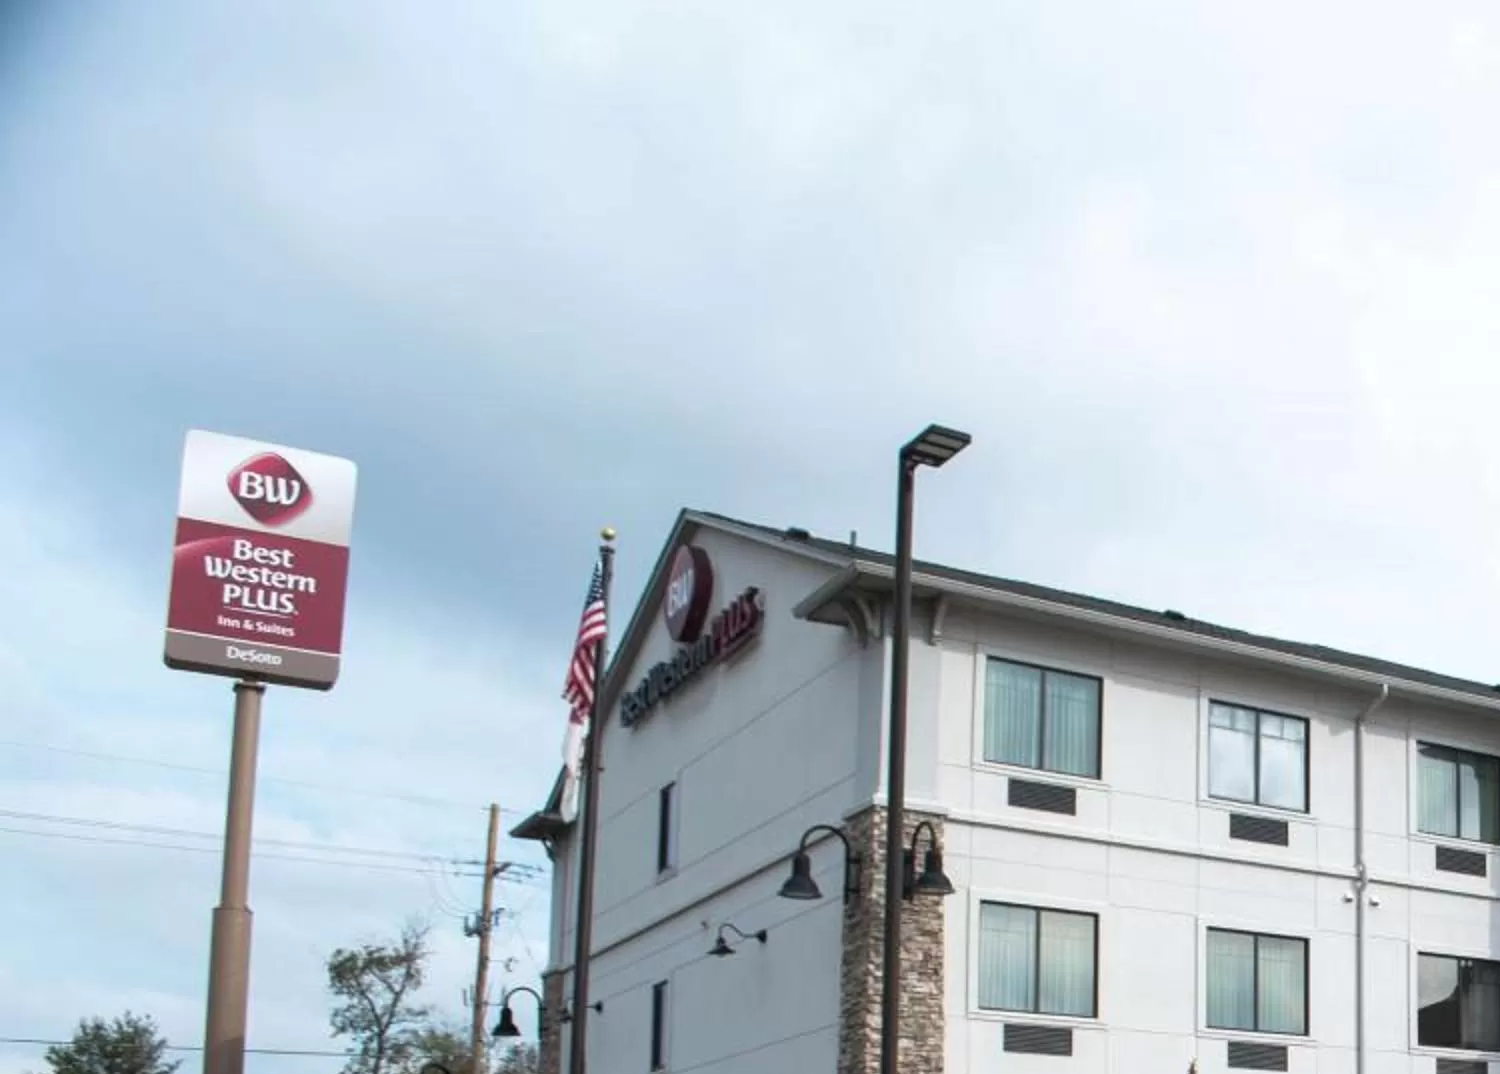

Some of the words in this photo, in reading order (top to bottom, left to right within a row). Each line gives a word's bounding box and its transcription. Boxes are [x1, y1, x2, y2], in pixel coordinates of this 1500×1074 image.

[239, 471, 300, 505] BW
[233, 539, 294, 568] Best
[204, 556, 316, 593] Western
[223, 584, 295, 614] PLUS
[217, 614, 240, 629] Inn
[243, 619, 254, 631] &
[256, 620, 295, 637] Suites
[226, 646, 282, 665] DeSoto
